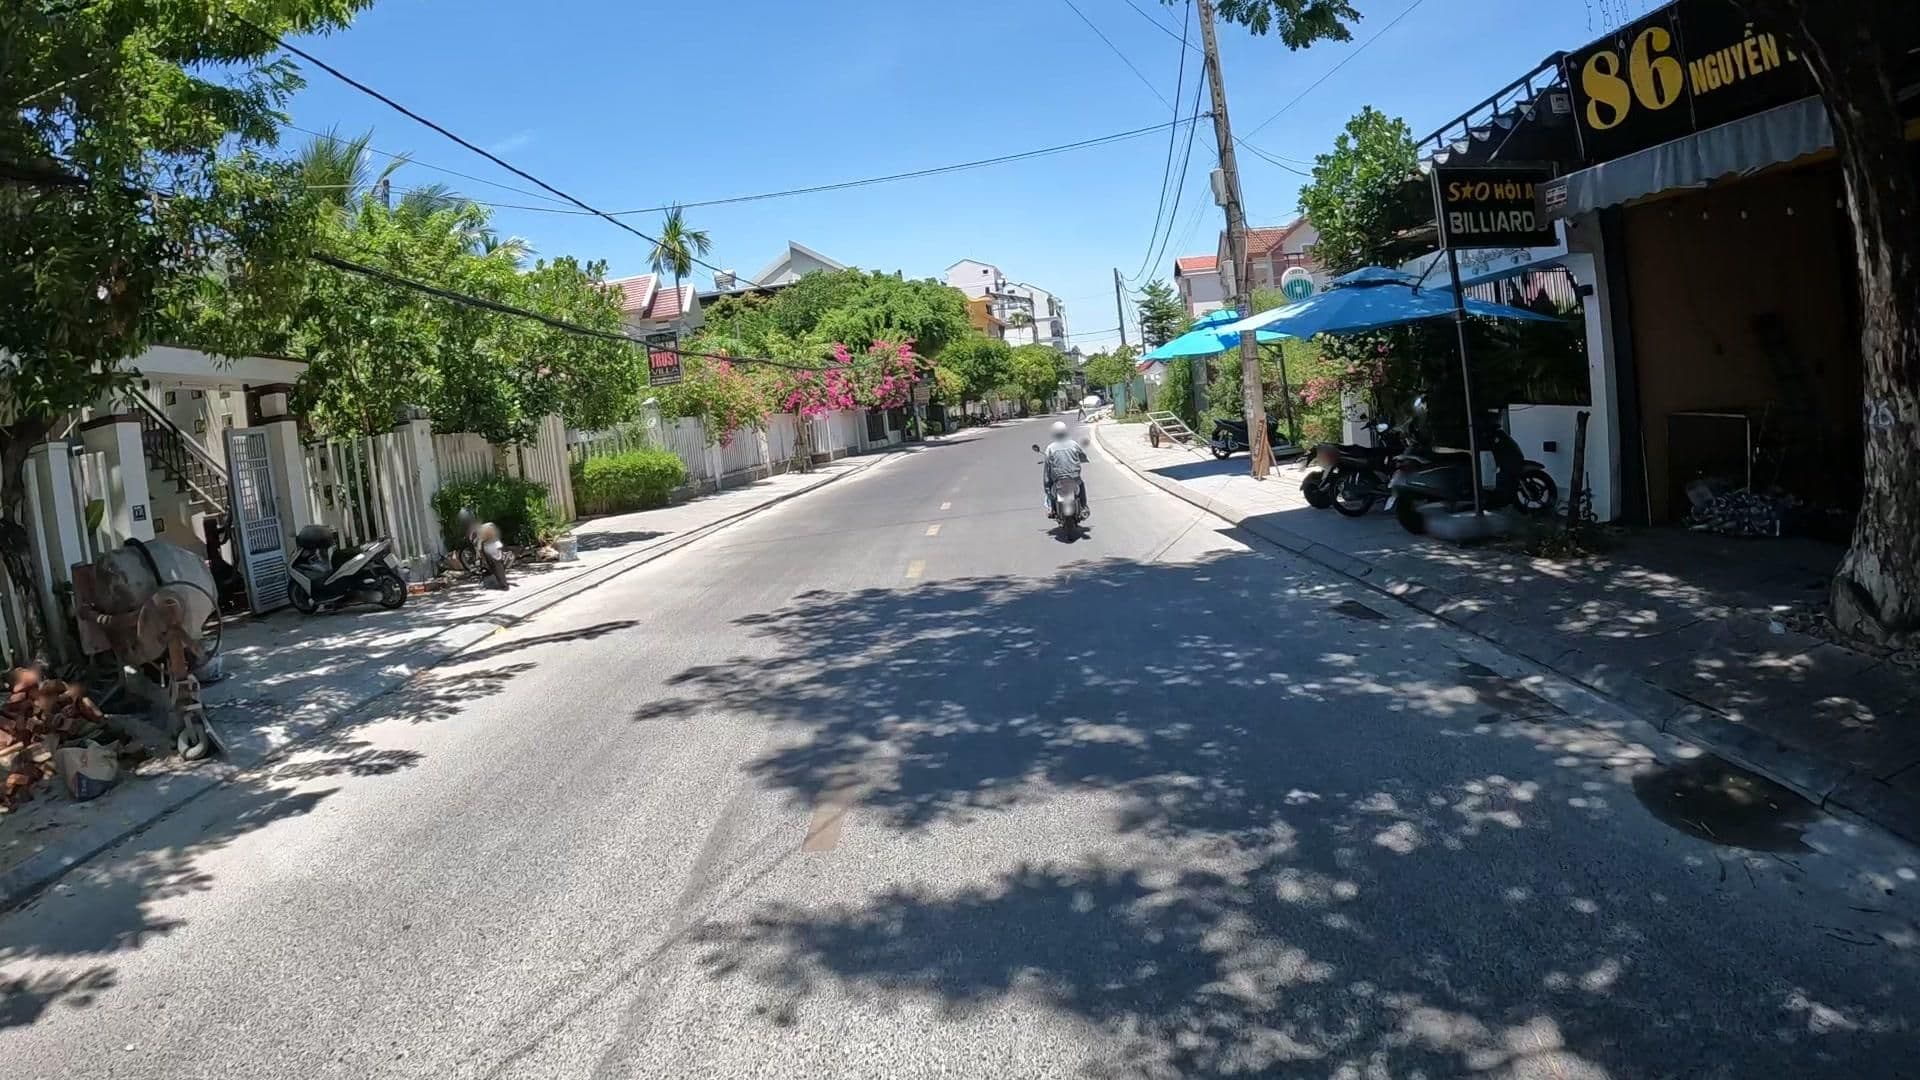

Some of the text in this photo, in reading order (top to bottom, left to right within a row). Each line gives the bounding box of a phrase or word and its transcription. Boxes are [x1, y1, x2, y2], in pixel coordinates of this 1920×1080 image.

[1582, 26, 1683, 129] 86
[1448, 210, 1548, 234] BILLIARD
[650, 351, 678, 368] TRUST
